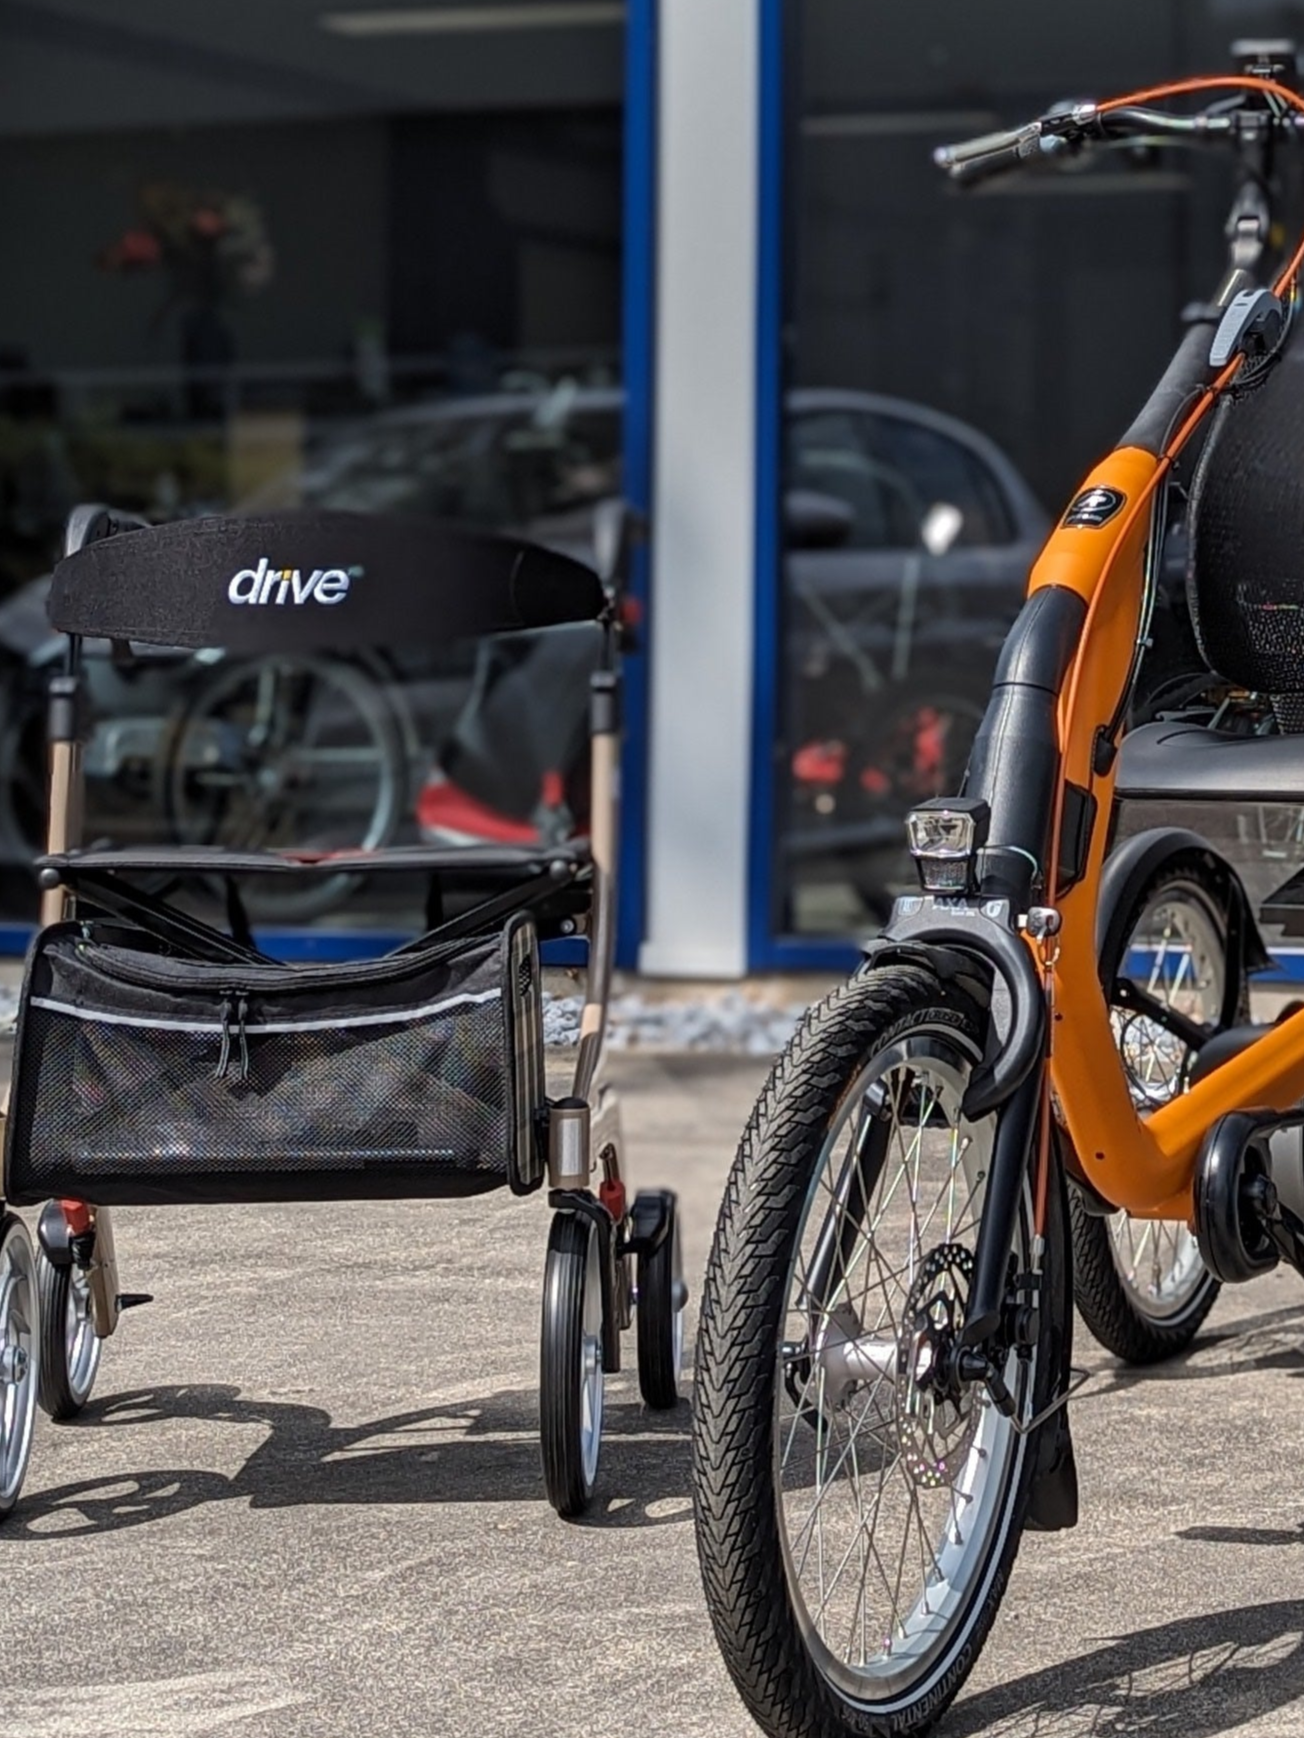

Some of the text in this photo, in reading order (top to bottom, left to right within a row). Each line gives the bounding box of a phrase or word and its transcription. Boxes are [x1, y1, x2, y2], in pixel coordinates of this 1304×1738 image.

[228, 557, 350, 605] drive
[932, 897, 970, 911] AXA
[891, 1642, 973, 1732] CONTINENTAL
